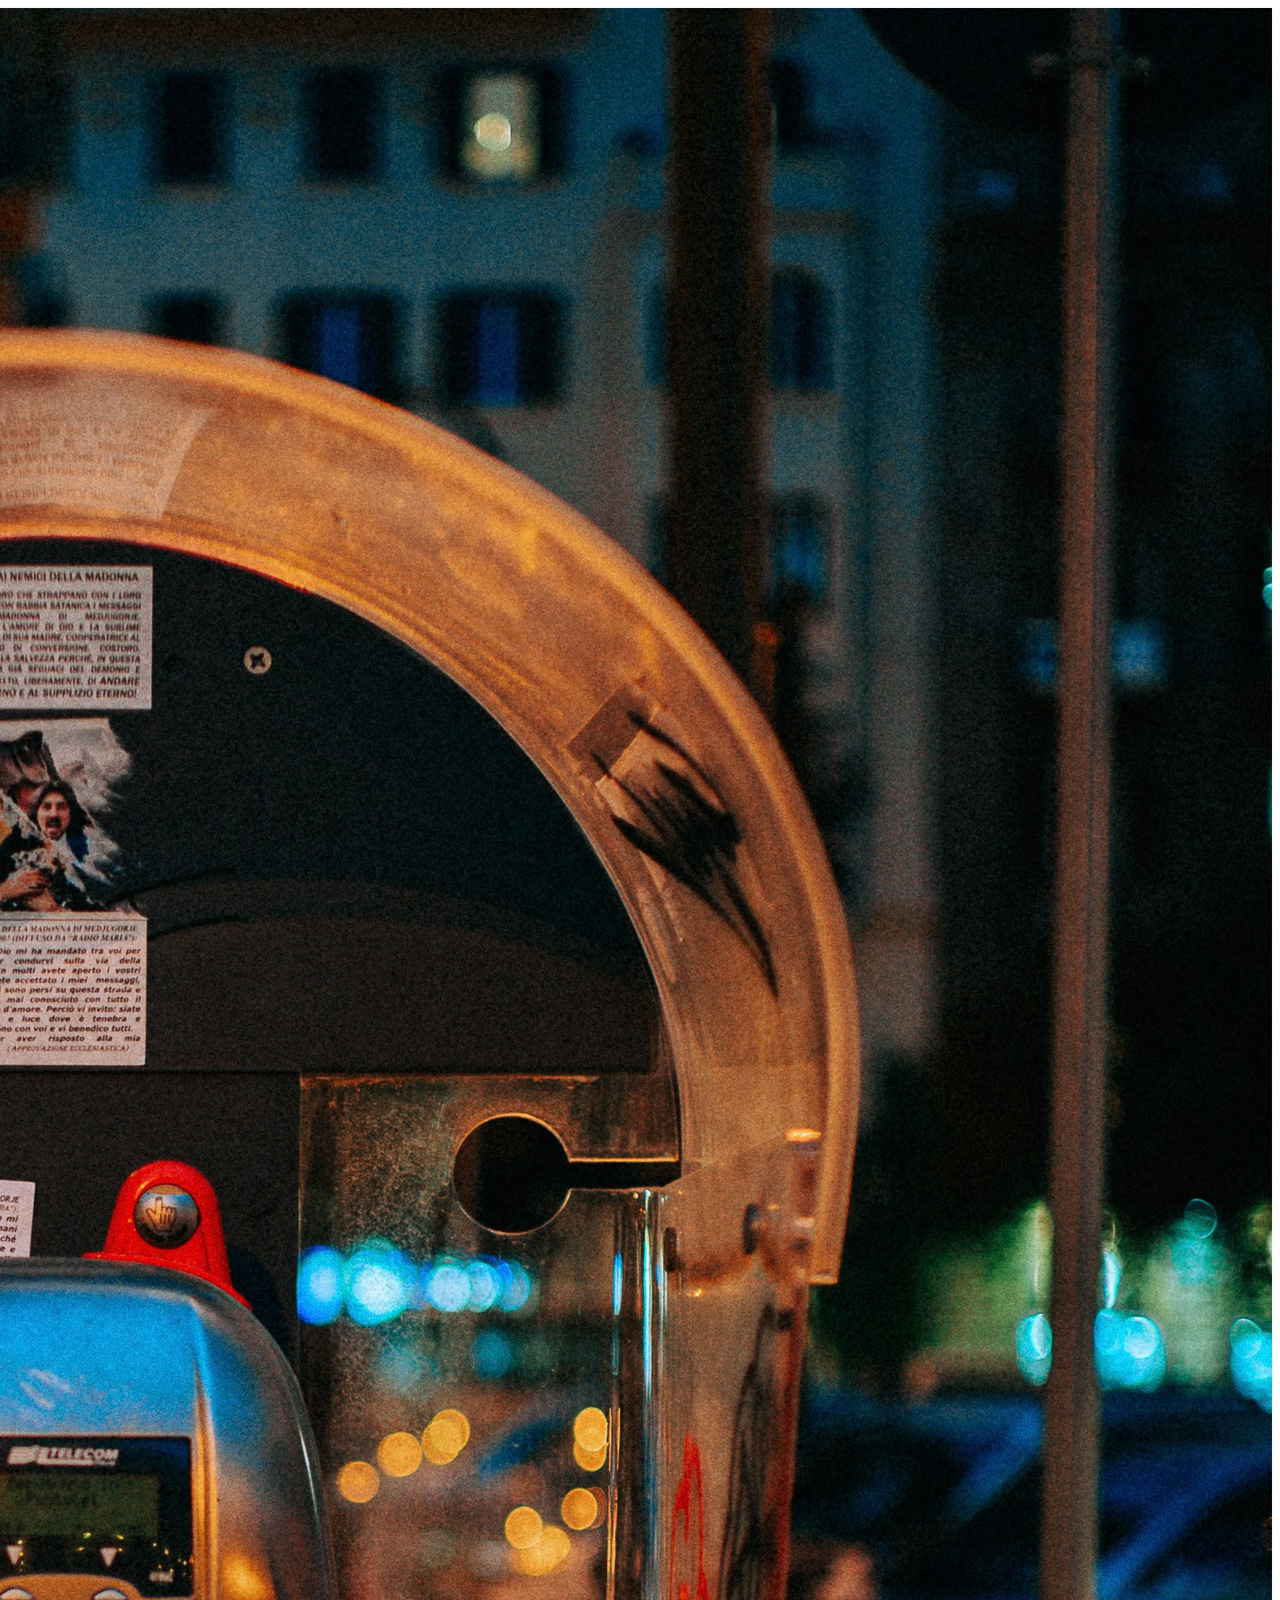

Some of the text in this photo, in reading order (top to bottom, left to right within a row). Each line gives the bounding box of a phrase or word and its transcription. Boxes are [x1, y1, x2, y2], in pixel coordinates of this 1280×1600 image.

[10, 572, 46, 581] NEMICI
[50, 572, 82, 581] DELLA
[86, 572, 138, 581] MADONNA
[19, 689, 24, 698] E
[43, 689, 93, 698] SUPPLIZIO
[96, 689, 137, 698] ETERNO!
[96, 977, 140, 985] messaggi,
[29, 987, 52, 995] persi
[70, 987, 100, 995] questa
[48, 1035, 85, 1043] risposto
[50, 1448, 119, 1460] TELECOM
